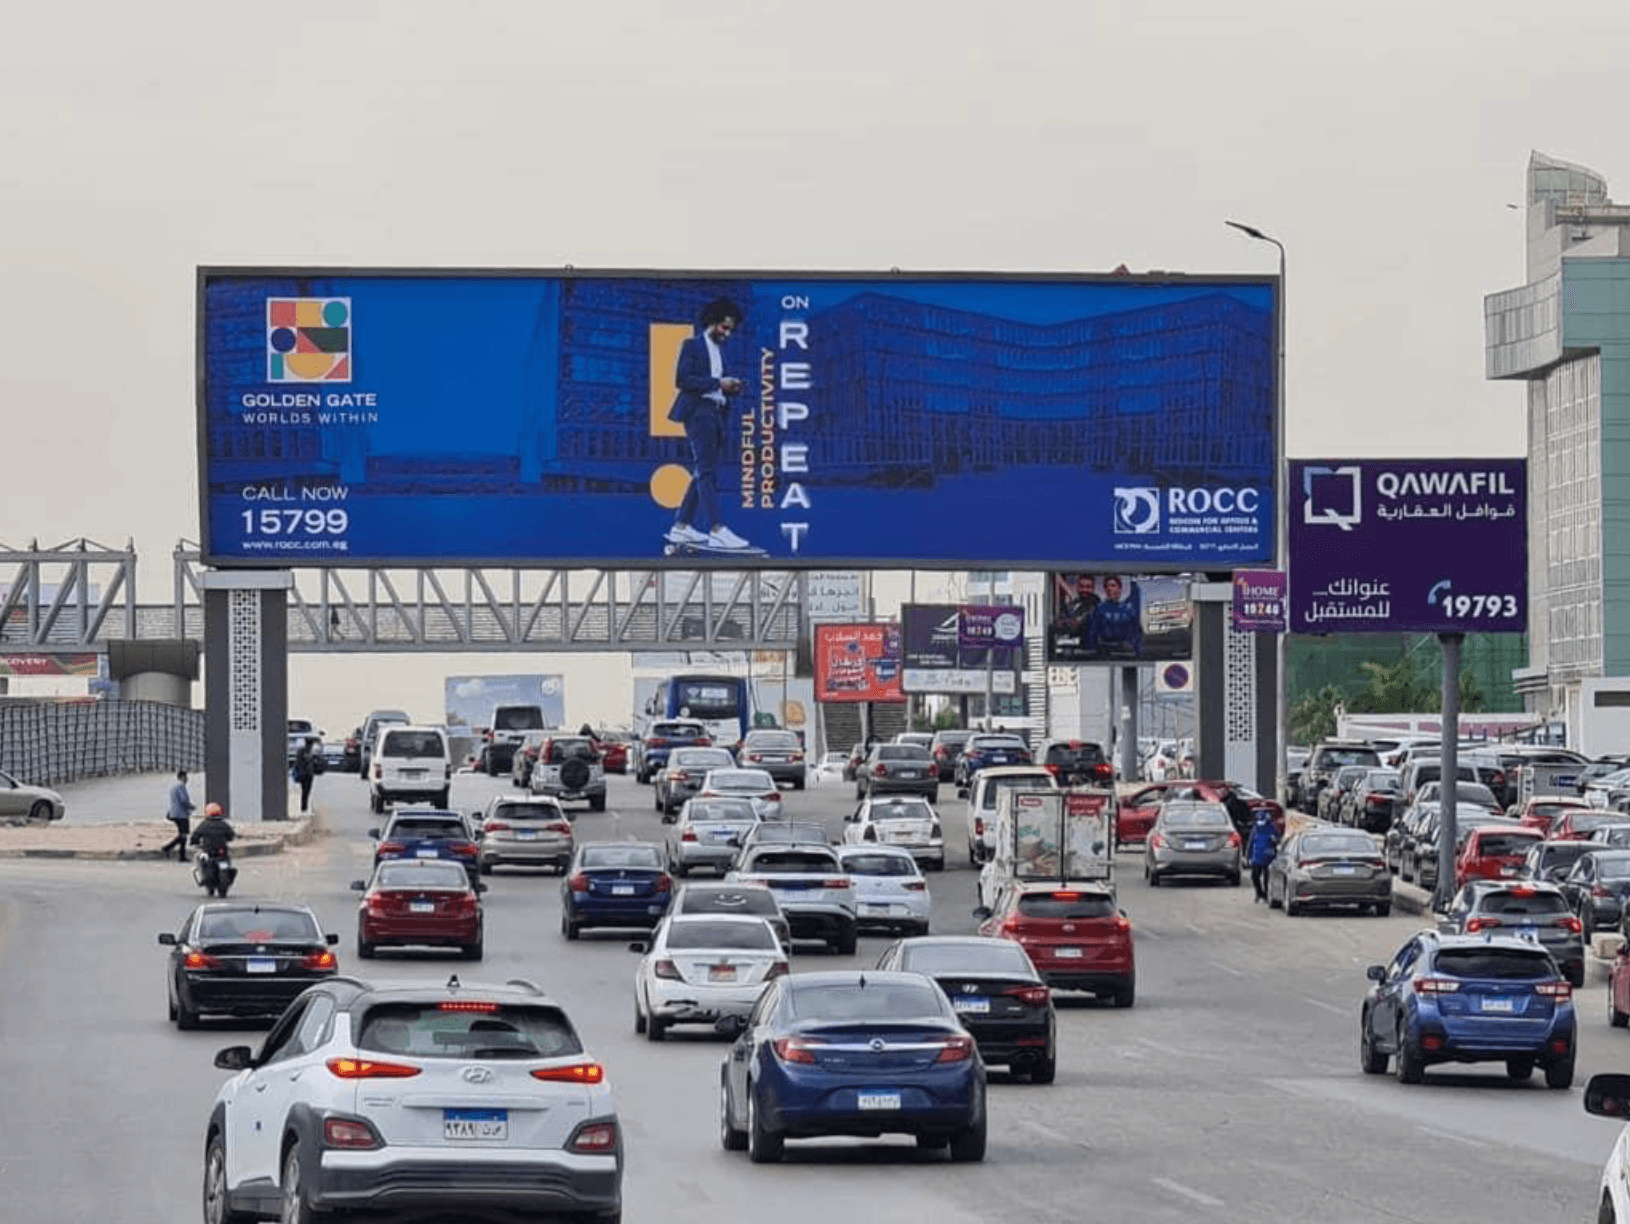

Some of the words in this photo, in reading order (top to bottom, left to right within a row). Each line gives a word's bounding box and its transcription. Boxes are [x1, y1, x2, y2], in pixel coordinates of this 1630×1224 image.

[781, 294, 809, 309] ON
[242, 393, 320, 407] GOLDEN
[327, 393, 377, 406] GATE
[242, 412, 311, 424] WORLDS
[318, 412, 378, 424] WITHIN
[761, 347, 774, 508] PRODUCTIVITY
[778, 322, 811, 551] REPEAT
[741, 407, 755, 508] MINDFUL
[242, 486, 296, 501] CALL
[302, 486, 349, 500] NOW
[1169, 487, 1259, 513] ROCC
[241, 509, 348, 534] 15799
[1377, 503, 1451, 520] العقارية
[1304, 600, 1390, 622] للمستقبل
[1442, 595, 1518, 618] 19793
